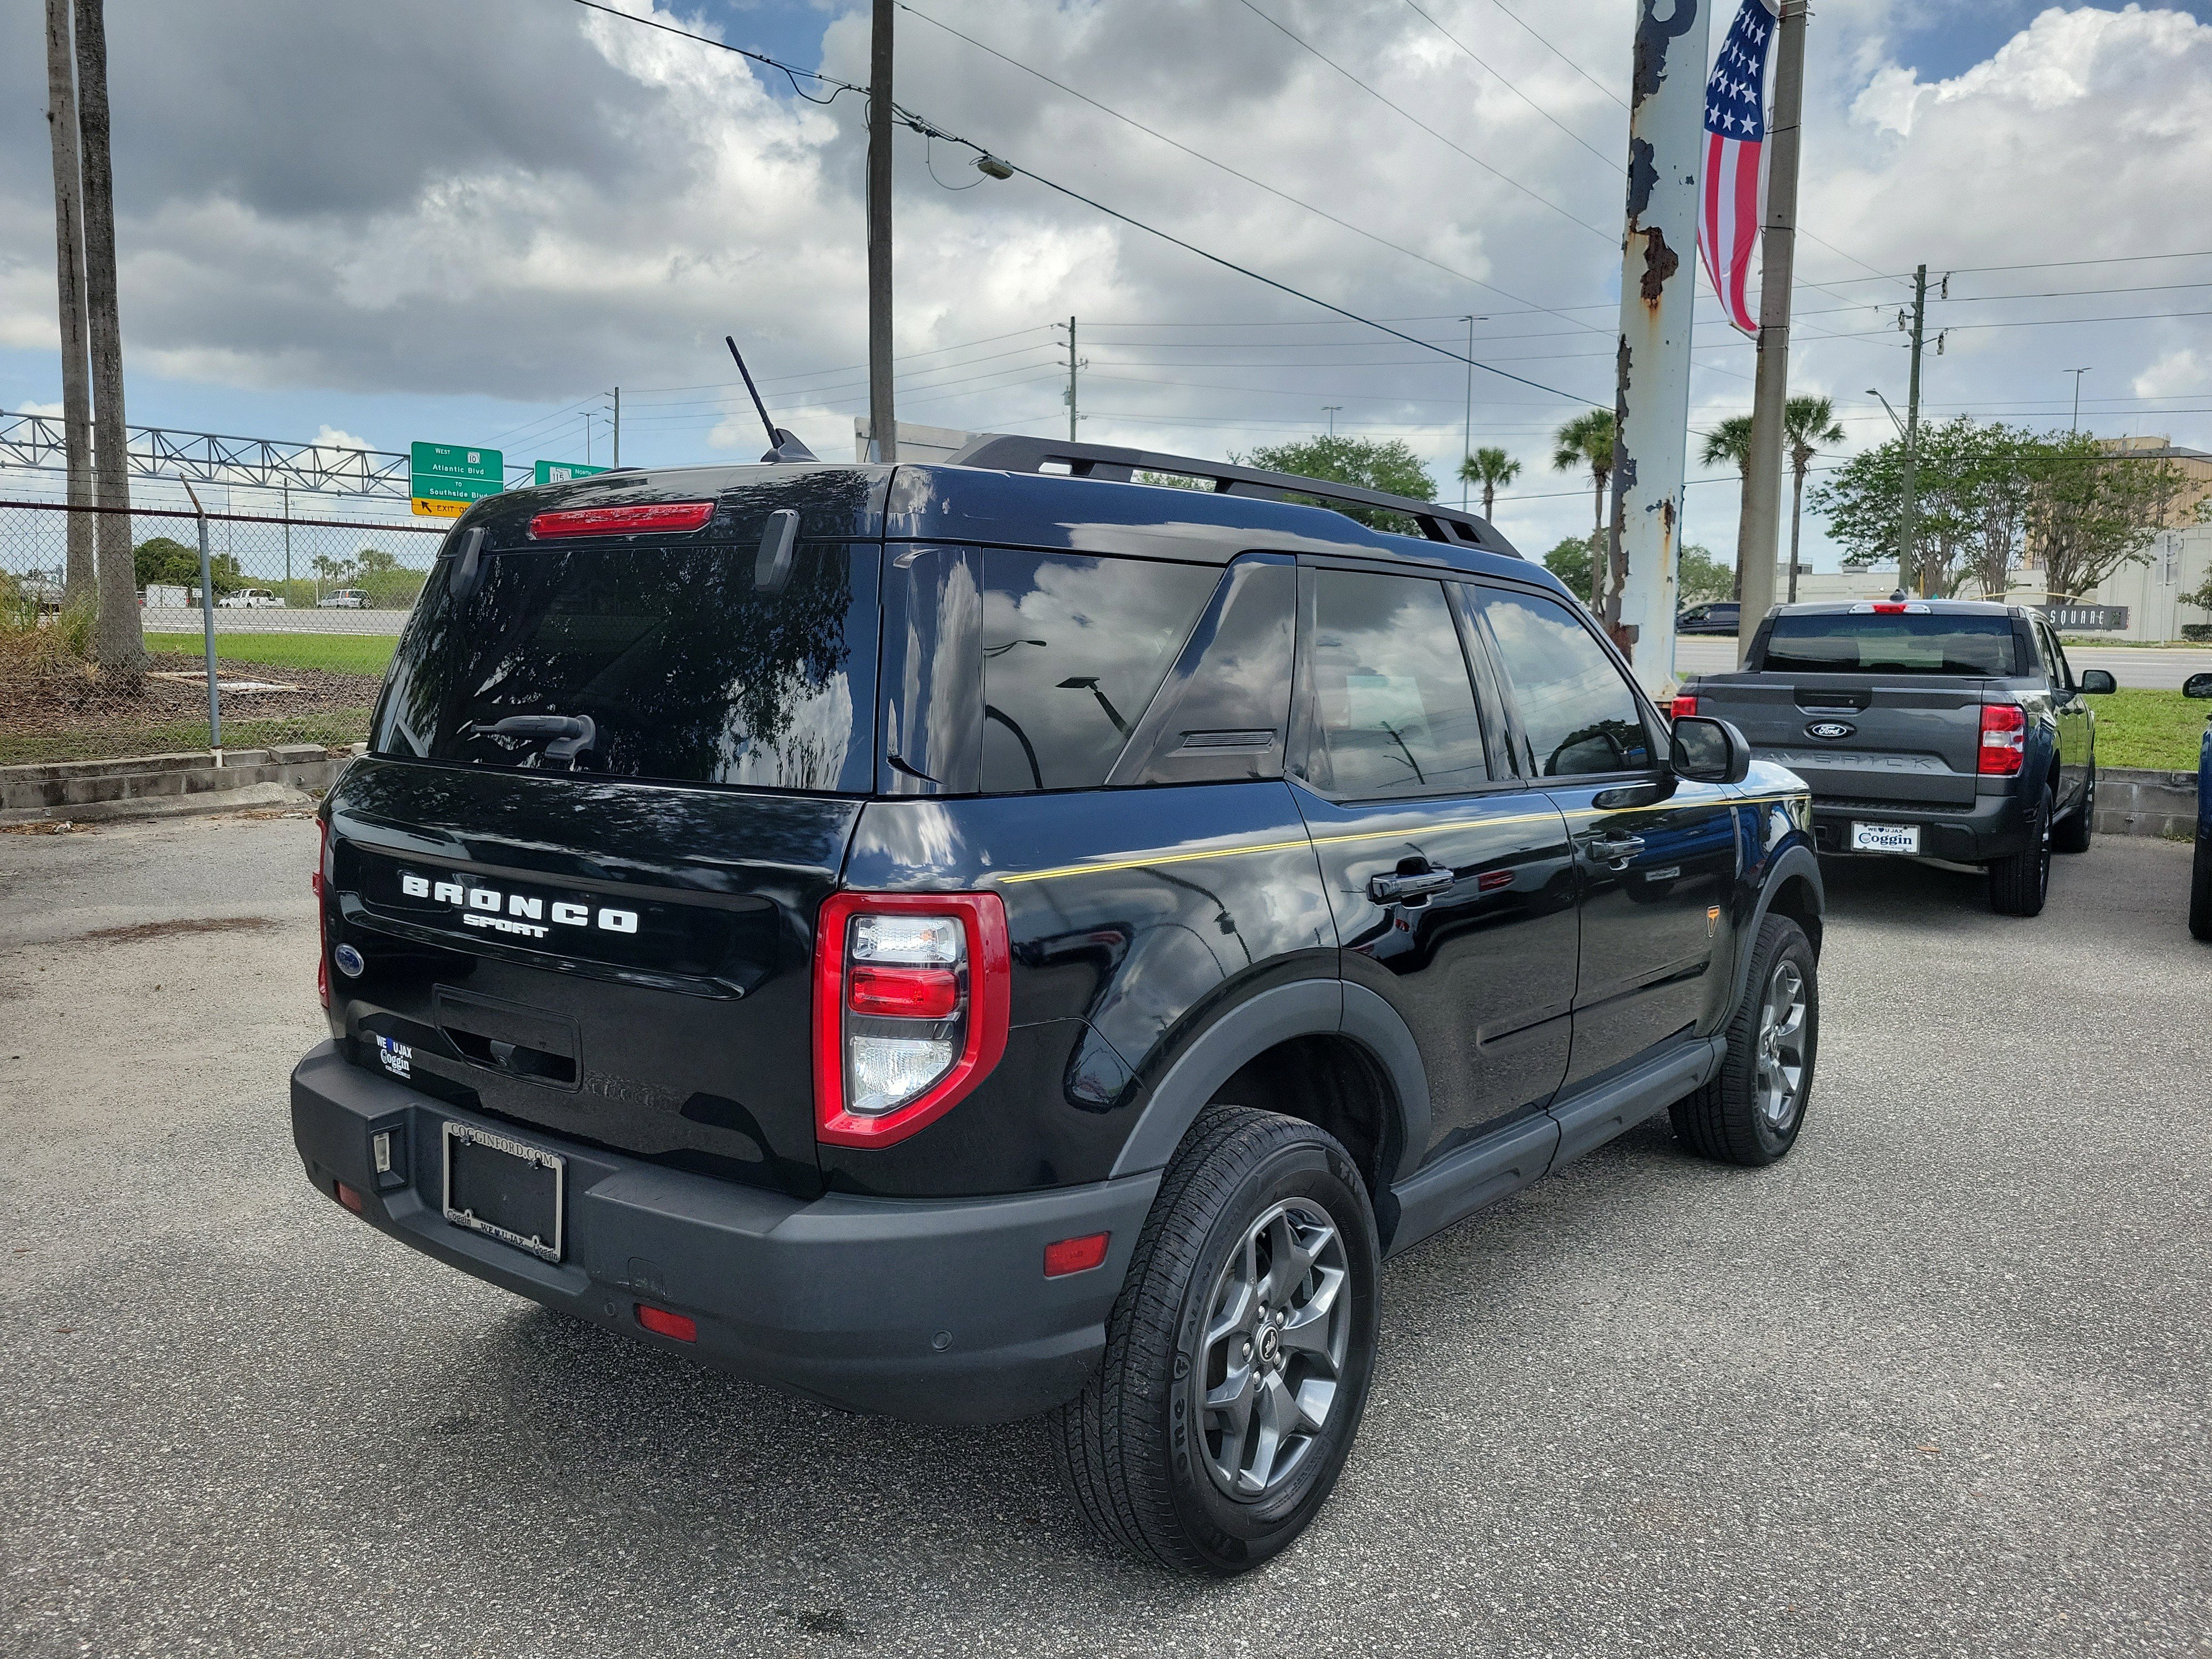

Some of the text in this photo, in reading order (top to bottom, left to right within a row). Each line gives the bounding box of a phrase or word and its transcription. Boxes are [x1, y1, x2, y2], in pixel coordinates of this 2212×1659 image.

[432, 464, 465, 473] Atlantic
[430, 488, 468, 498] Southside
[2050, 610, 2104, 625] SQUARE
[1859, 832, 1912, 845] Coggin
[403, 876, 638, 934] BRONCO
[463, 913, 549, 938] SPORT
[376, 1035, 413, 1059] WE U JAX
[380, 1048, 410, 1071] Coggin
[451, 1124, 554, 1167] COGGINFORD.COM
[447, 1210, 471, 1226] Coggin
[480, 1223, 494, 1235] WE
[508, 1233, 525, 1246] JAX
[533, 1244, 558, 1261] Coggin
